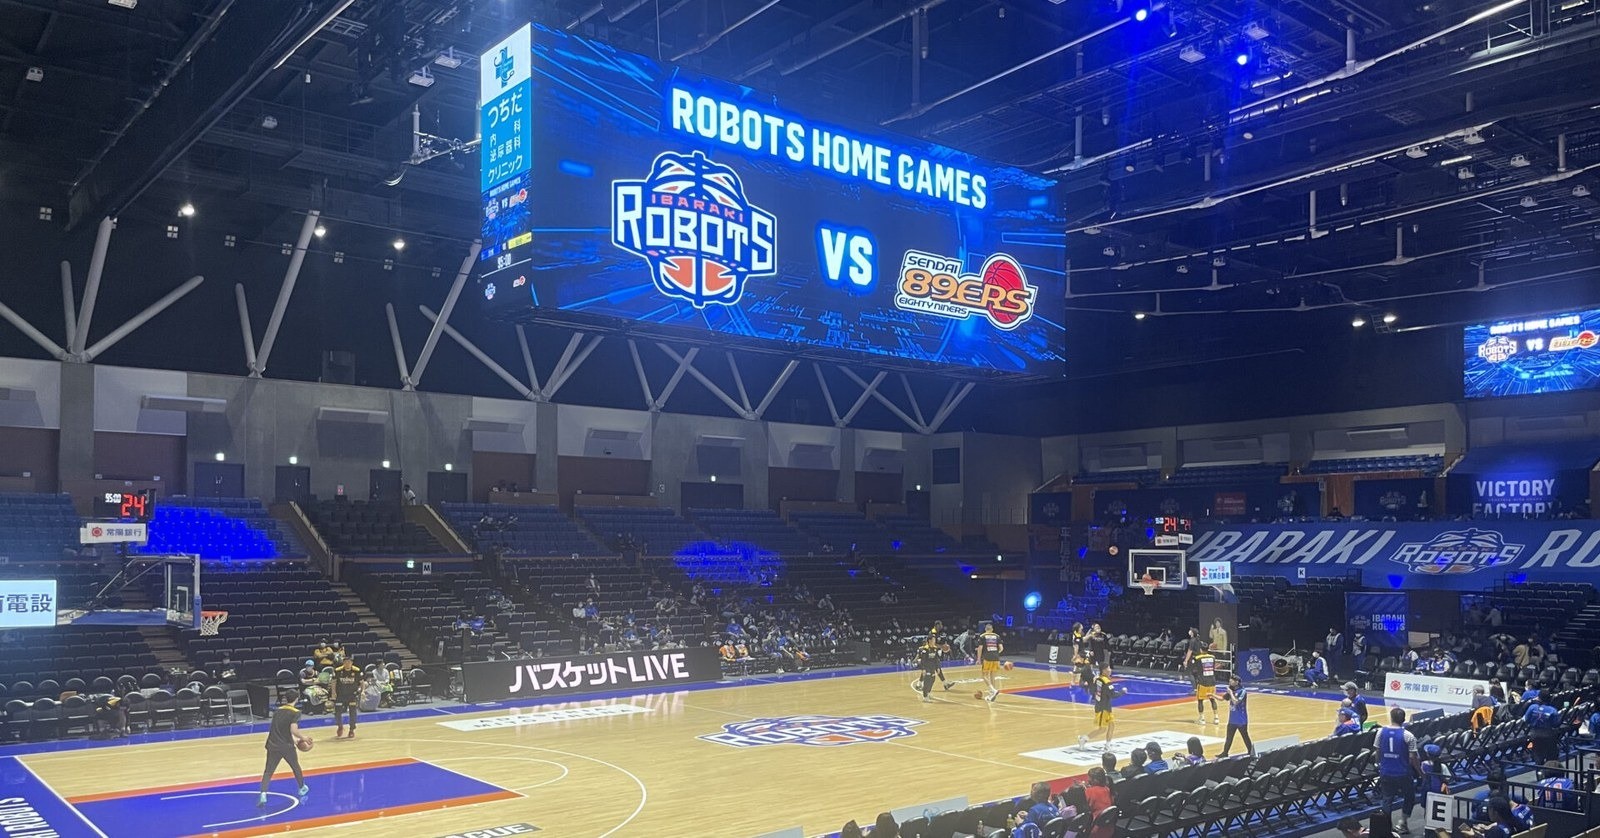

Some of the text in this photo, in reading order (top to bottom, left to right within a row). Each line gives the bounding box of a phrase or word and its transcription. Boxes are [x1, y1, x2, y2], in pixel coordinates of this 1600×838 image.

[488, 87, 523, 128] つちだ
[672, 88, 986, 209] ROBOTS HOME GAMES
[488, 154, 523, 184] クリニック
[652, 193, 743, 222] IBARAKI
[617, 186, 772, 271] ROBOTS
[821, 228, 872, 285] VS
[907, 255, 958, 274] SENDAI
[902, 268, 1031, 313] 89ERS
[899, 296, 932, 310] EIGHTY
[1526, 338, 1544, 351] VS
[1476, 479, 1555, 497] VICTORY
[121, 494, 144, 516] 24
[1164, 517, 1177, 531] 24
[1186, 530, 1396, 564] IBARAKI
[1395, 544, 1520, 564] ROBOTS
[423, 564, 431, 572] M
[0, 594, 52, 613] 電設
[509, 653, 689, 693] バスケットLIVE
[704, 716, 921, 747] ROBOTS
[1389, 737, 1393, 753] 1
[1432, 800, 1446, 822] E
[445, 824, 533, 838] GUE
